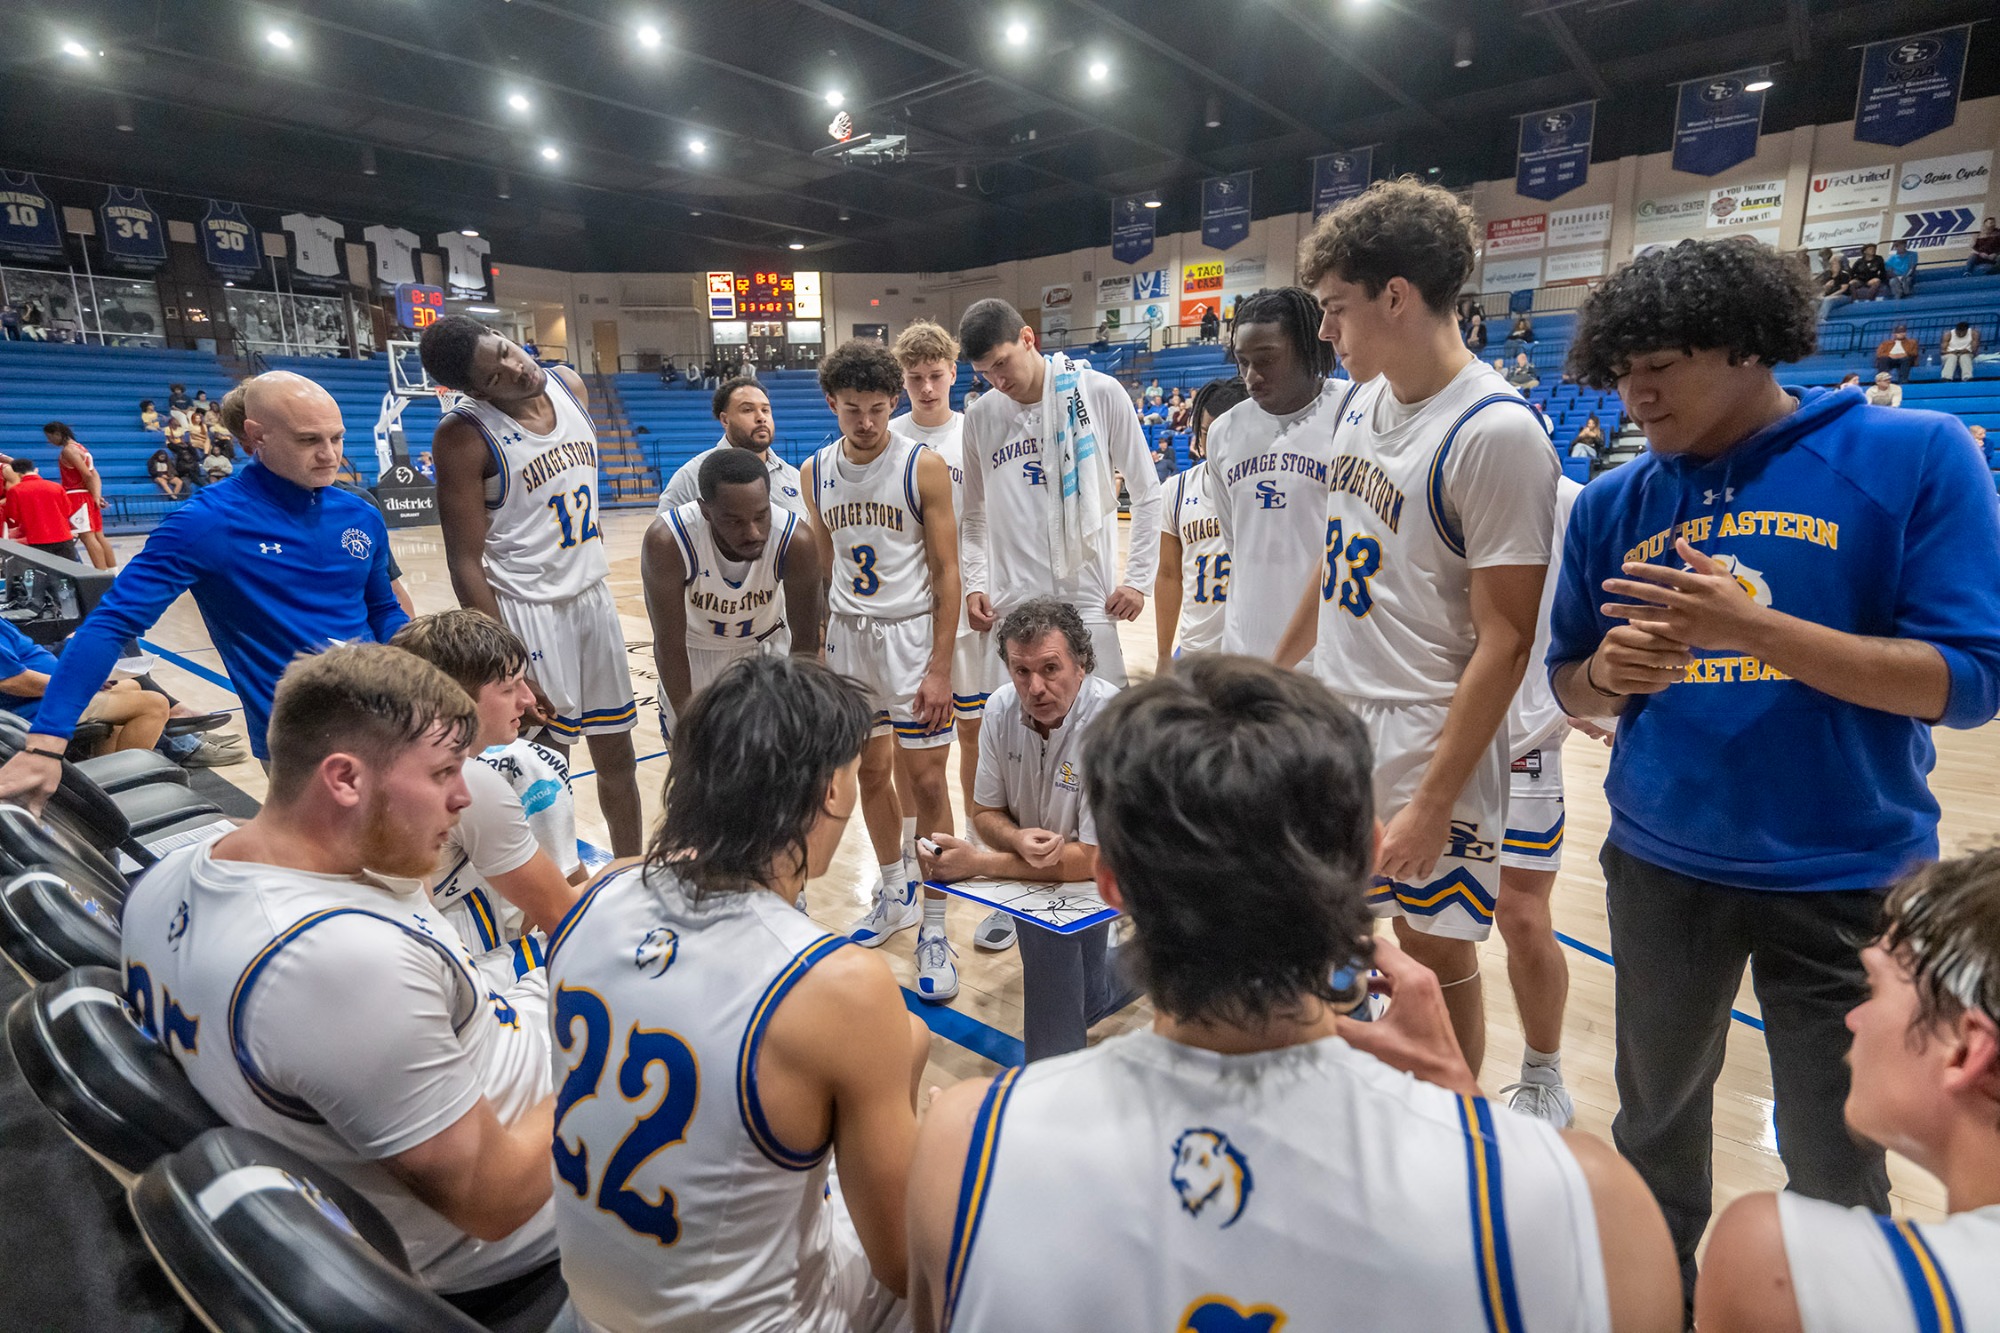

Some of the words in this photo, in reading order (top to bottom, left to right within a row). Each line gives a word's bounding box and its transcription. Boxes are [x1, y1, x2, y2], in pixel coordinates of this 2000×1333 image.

[1923, 172, 1952, 185] Spin
[1956, 165, 1989, 180] Cycle
[1727, 186, 1741, 196] YOU
[1744, 183, 1766, 192] THINK
[6, 204, 39, 227] 10
[1491, 223, 1508, 231] Jim
[1511, 215, 1544, 229] McGill
[1551, 210, 1610, 227] ROADHOUSE
[1729, 217, 1744, 225] CAN
[1856, 220, 1879, 233] Store
[115, 218, 149, 240] 34
[215, 230, 245, 251] 30
[1197, 265, 1223, 277] TACO
[736, 279, 750, 291] 62
[780, 279, 794, 291] 56
[1197, 277, 1221, 289] CASA
[411, 289, 443, 306] 8:18
[992, 438, 1038, 470] SAVAGE
[522, 447, 567, 494] SAVAGE
[564, 440, 597, 472] STORM
[1227, 453, 1278, 488] SAVAGE
[1281, 452, 1328, 485] STORM
[384, 496, 434, 511] district
[1366, 464, 1405, 535] STORM
[548, 484, 599, 549] 12
[865, 502, 904, 532] STORM
[1182, 517, 1220, 546] SAVAGE
[851, 544, 882, 597] 3
[1194, 552, 1232, 605] 15
[1322, 516, 1383, 621] 33
[690, 590, 737, 615] SAVAGE
[738, 588, 774, 611] STORM
[707, 617, 755, 638] 11
[551, 977, 701, 1247] 22
